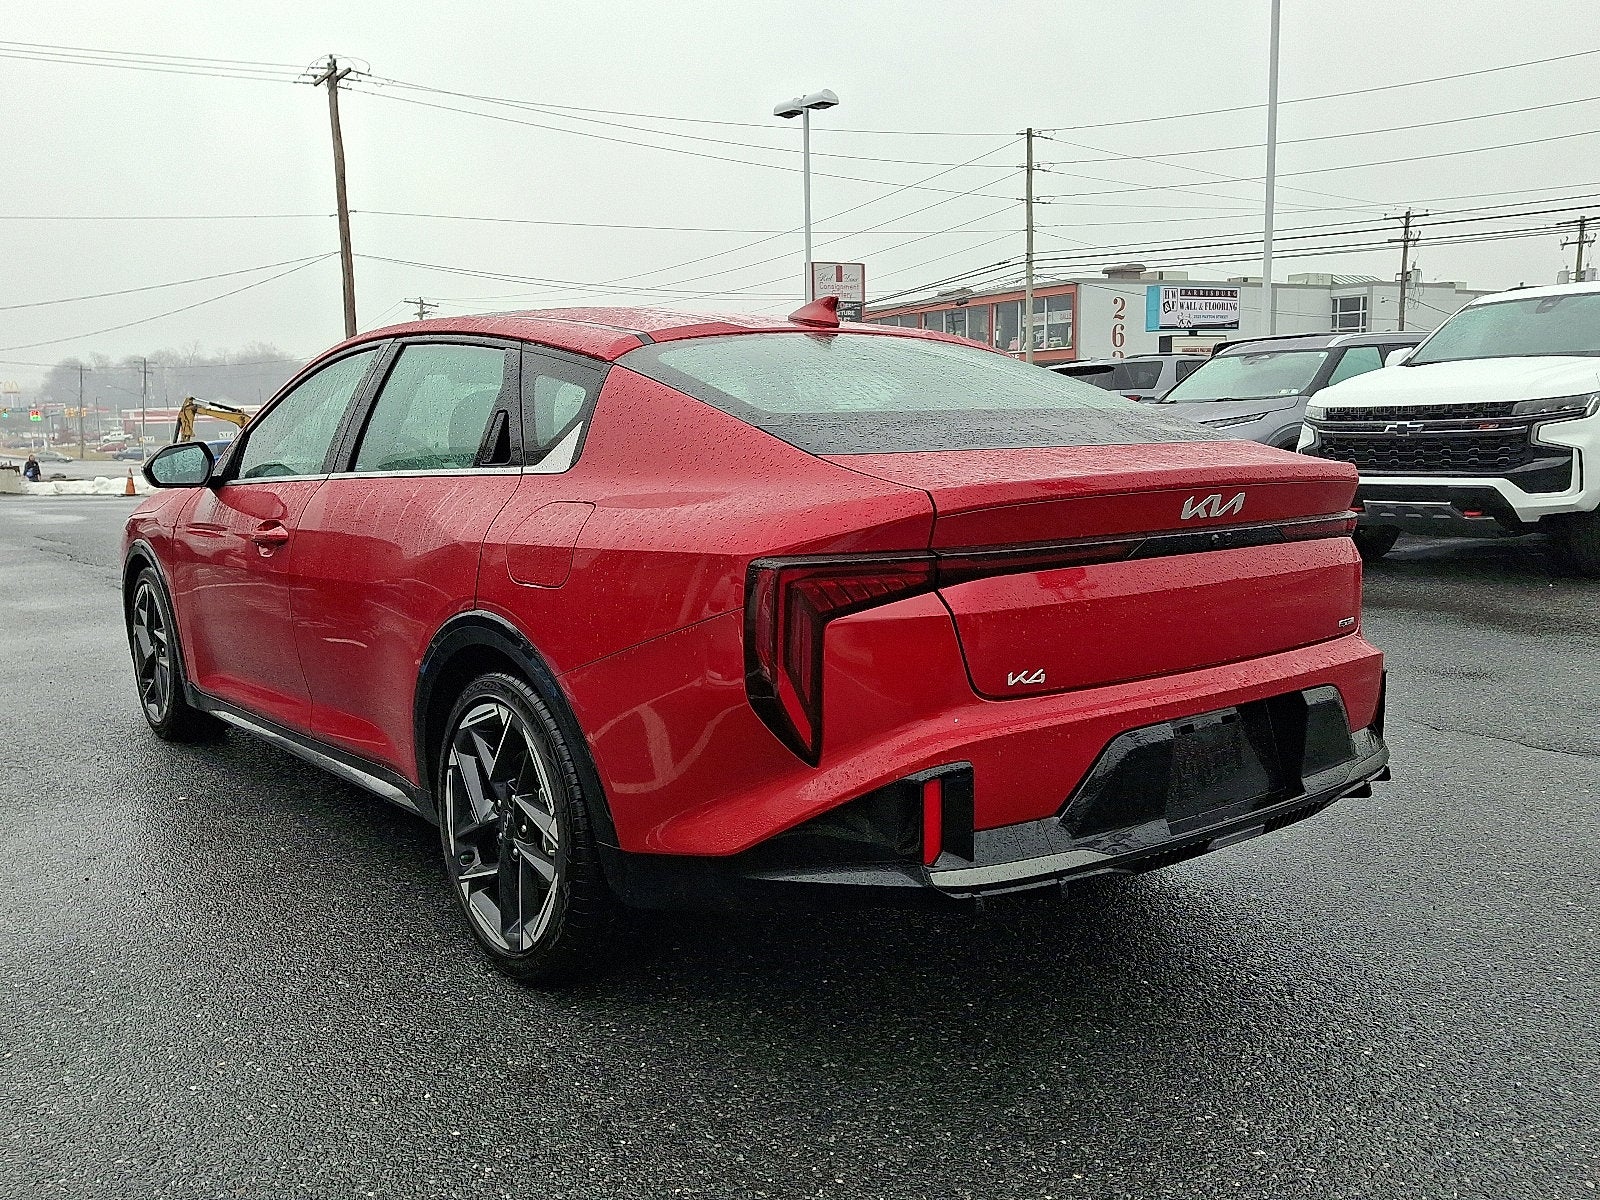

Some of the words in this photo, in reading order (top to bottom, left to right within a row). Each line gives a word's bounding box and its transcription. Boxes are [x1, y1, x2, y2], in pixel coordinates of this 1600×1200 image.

[820, 282, 859, 290] Consignment
[1180, 289, 1237, 297] HARRISBURG
[1180, 301, 1197, 311] WALL
[1199, 302, 1204, 311] &
[1204, 301, 1238, 311] FLOORING
[1180, 492, 1246, 519] KIA
[1007, 668, 1046, 686] K4
